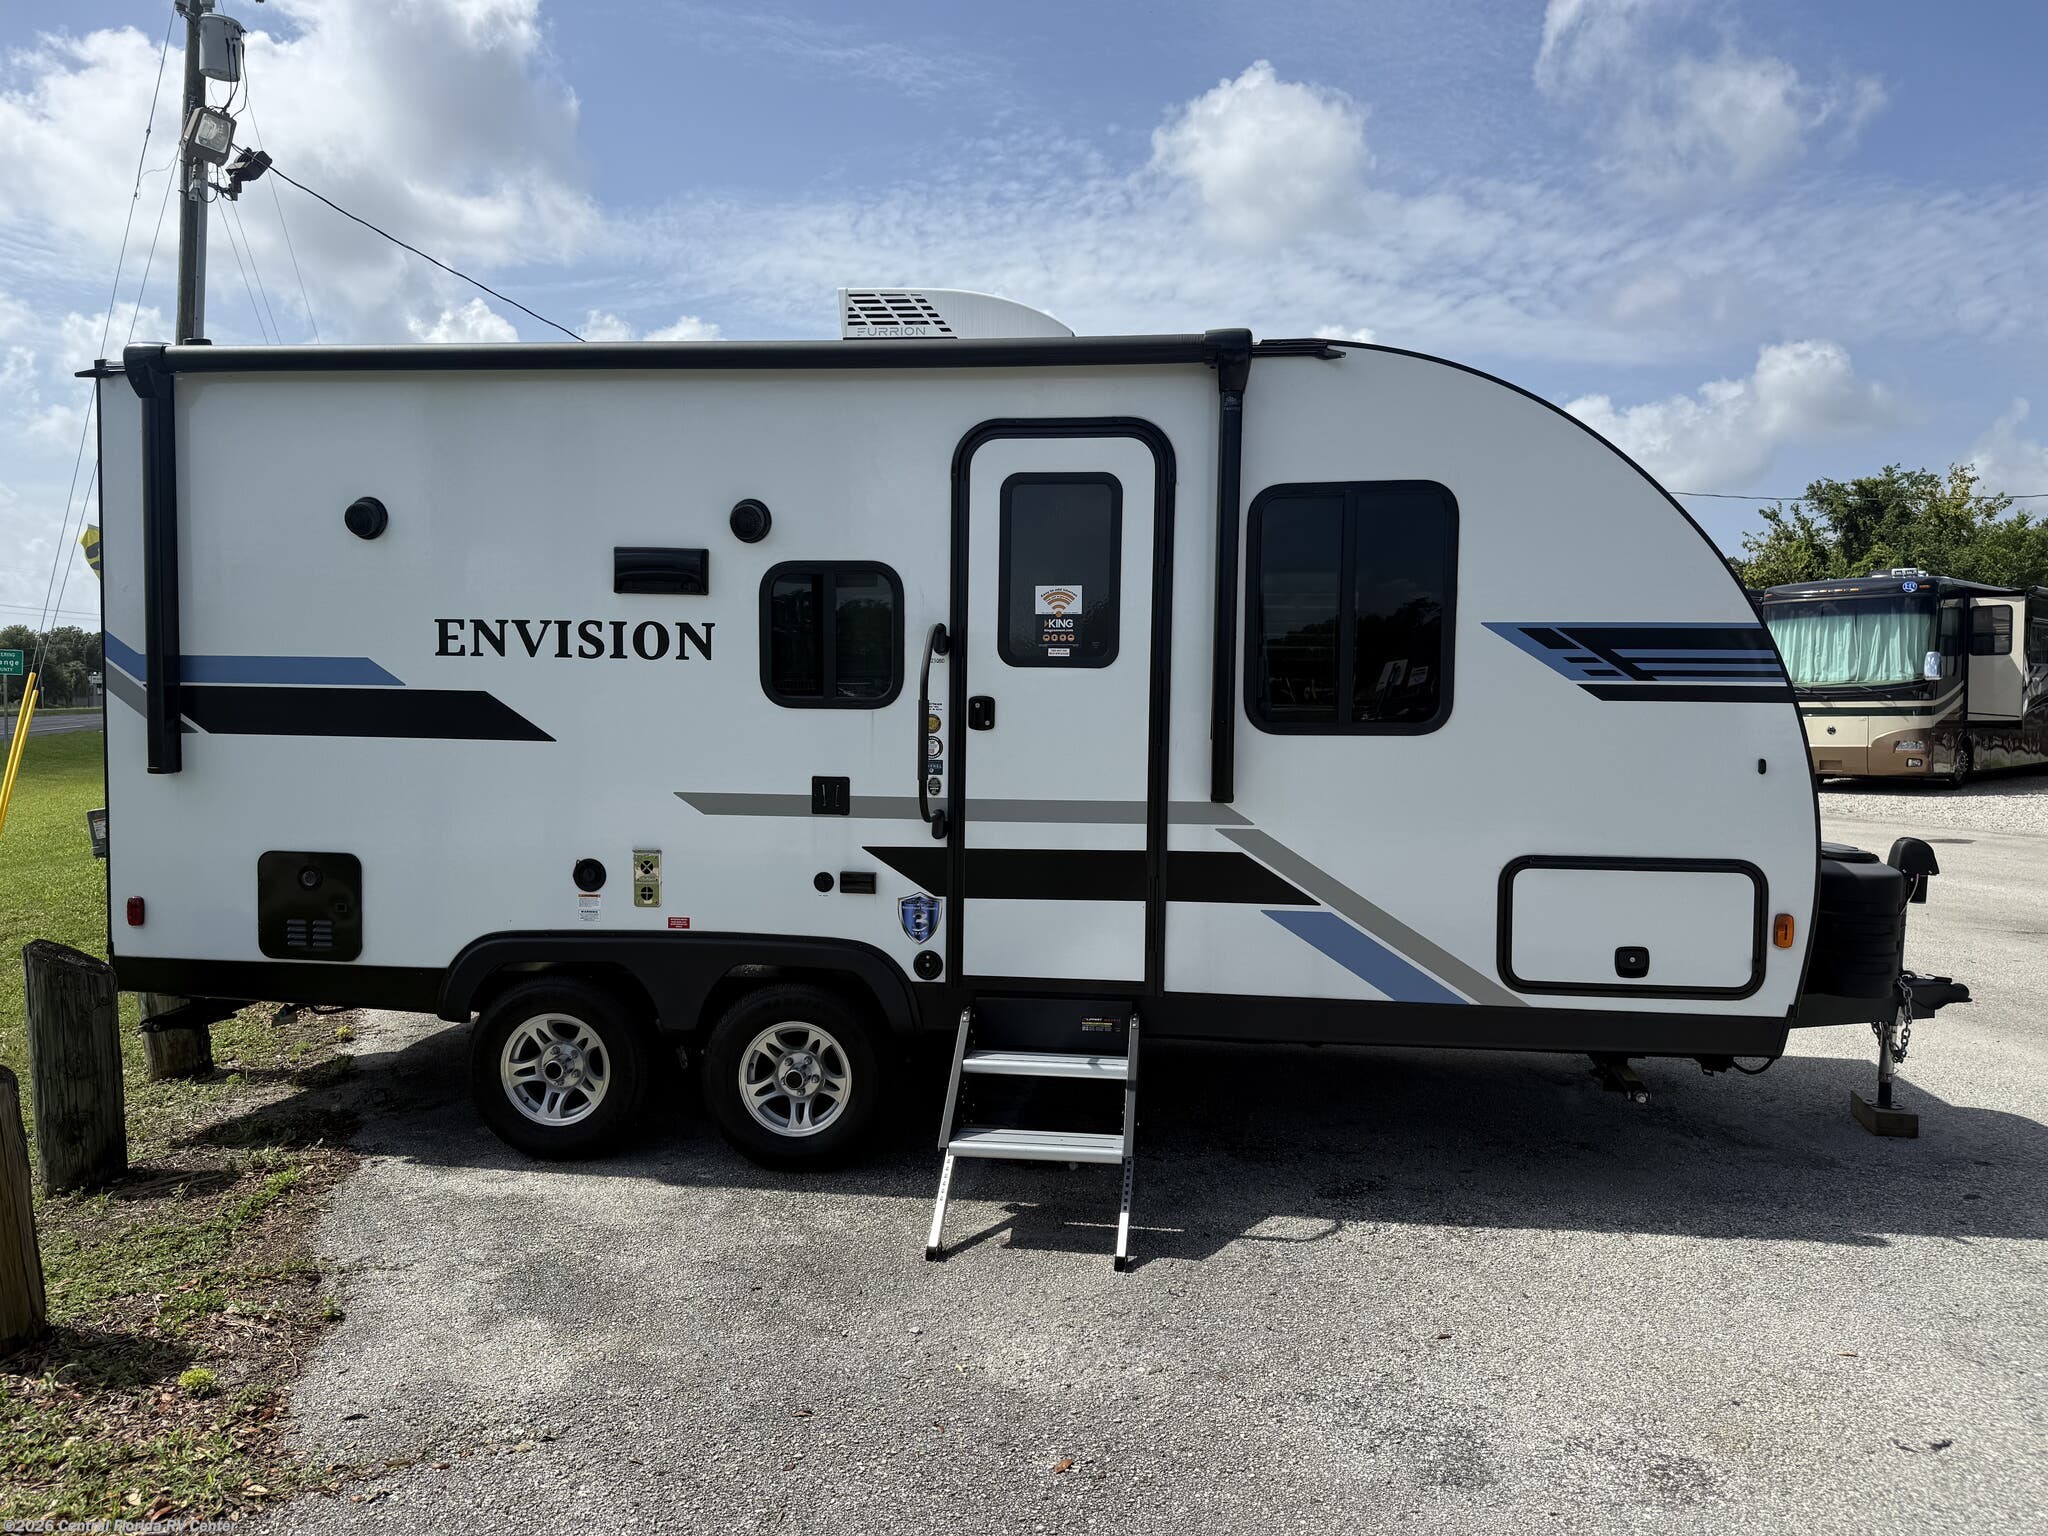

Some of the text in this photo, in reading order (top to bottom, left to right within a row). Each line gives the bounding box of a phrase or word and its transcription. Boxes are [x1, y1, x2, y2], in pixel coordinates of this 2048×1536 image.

[857, 326, 926, 337] FURRION
[1048, 619, 1074, 628] KING
[434, 618, 716, 661] ENVISION
